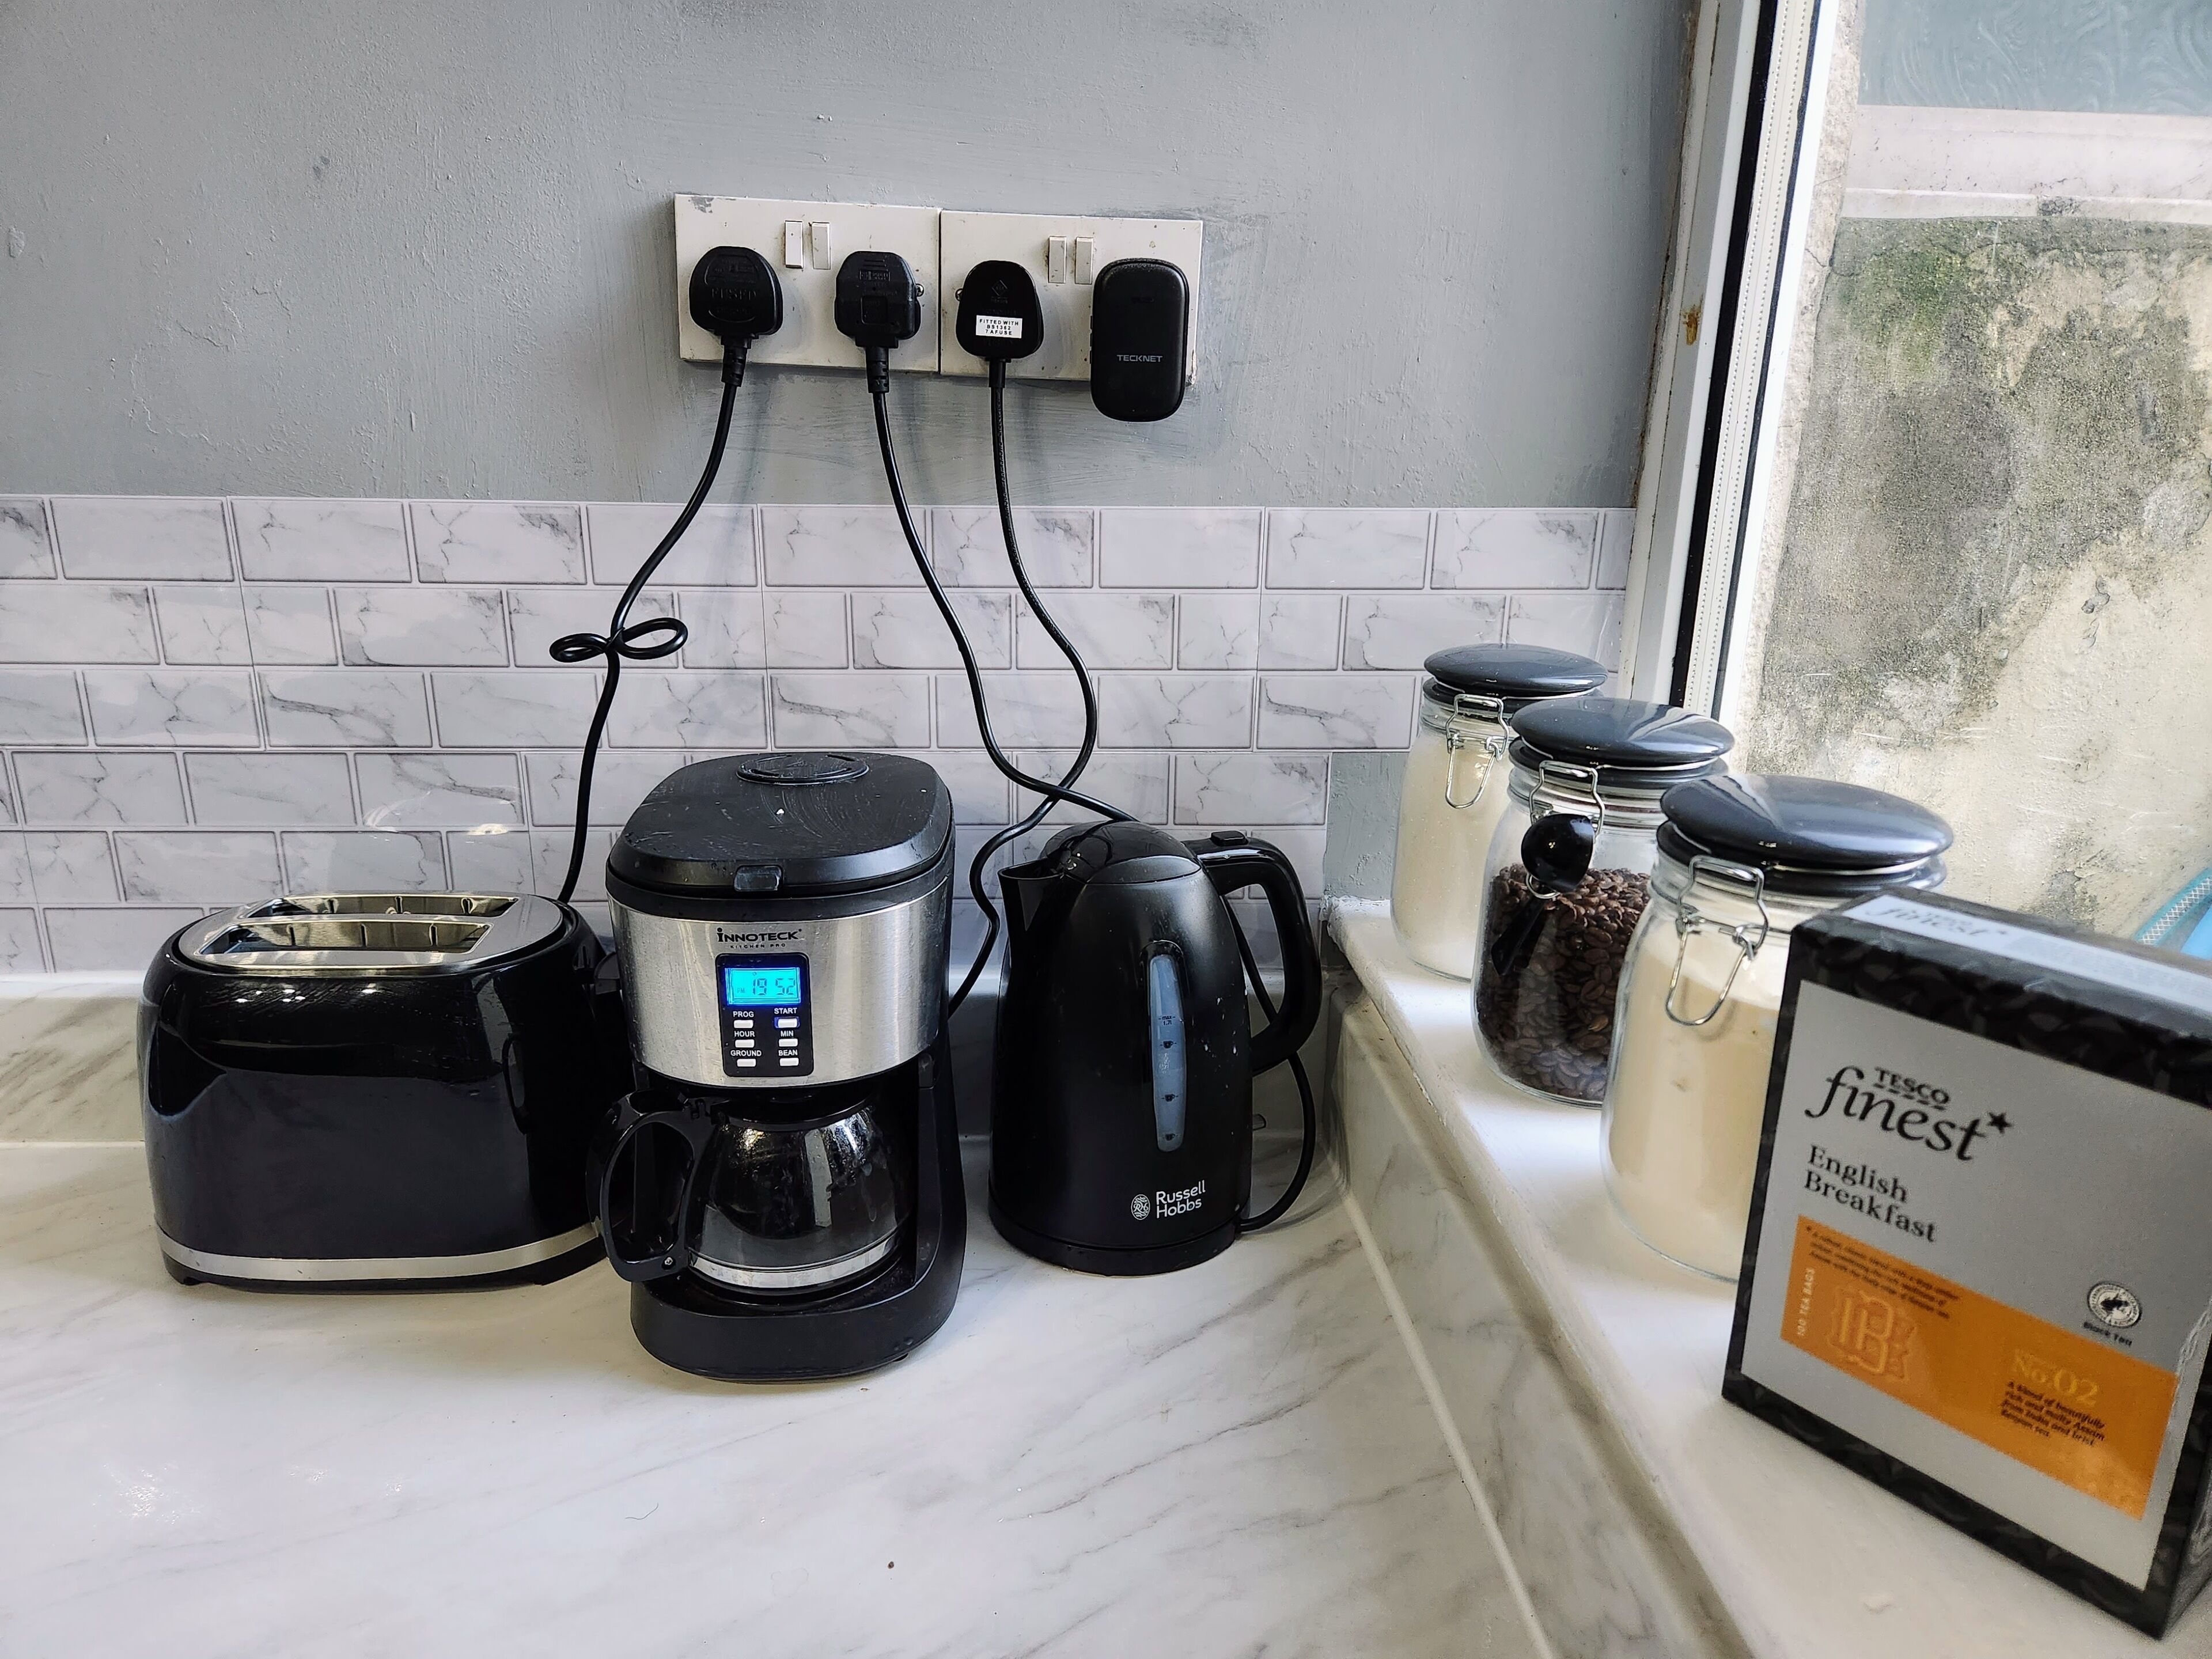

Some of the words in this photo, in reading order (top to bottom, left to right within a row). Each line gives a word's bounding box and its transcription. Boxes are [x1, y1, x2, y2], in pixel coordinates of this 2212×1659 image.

[1874, 1066, 1950, 1106] TESCO
[1156, 1180, 1206, 1205] Russell
[1808, 1144, 1907, 1205] English
[1156, 1199, 1202, 1219] Hobbs
[1804, 1169, 1936, 1243] Breakfast
